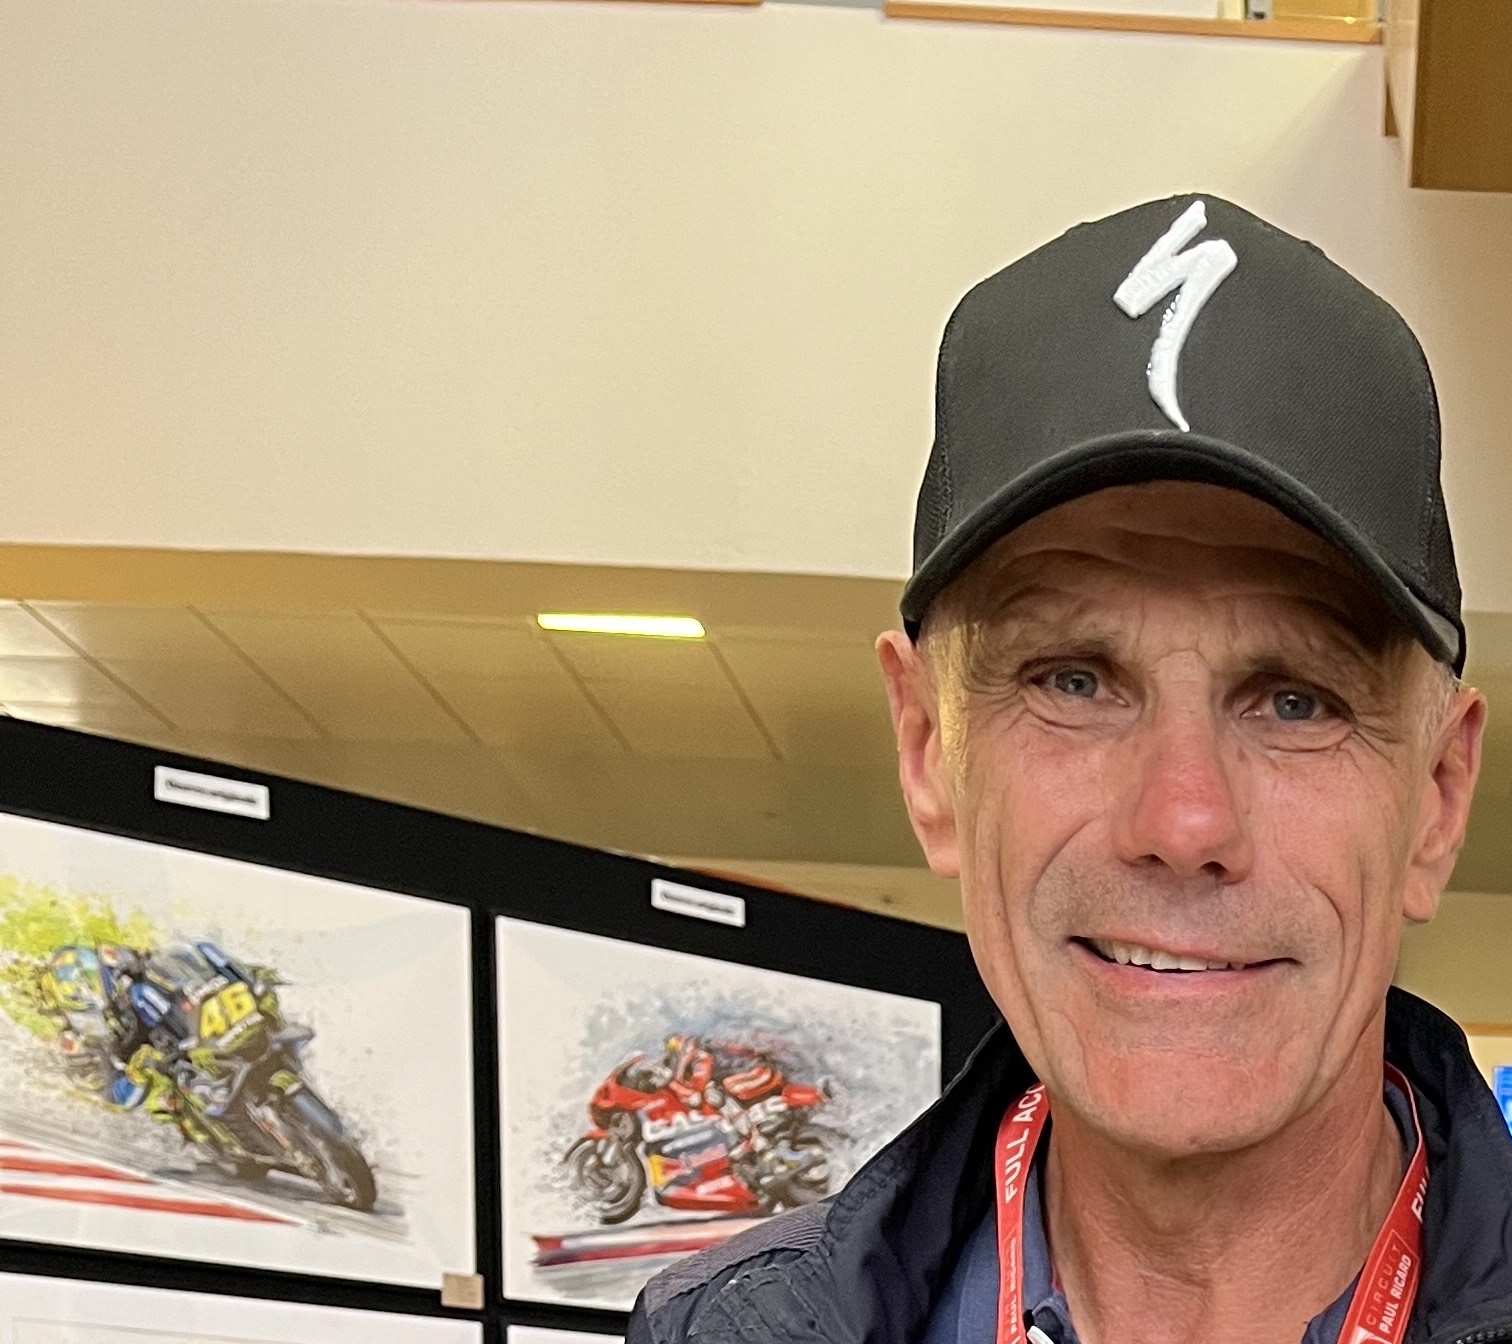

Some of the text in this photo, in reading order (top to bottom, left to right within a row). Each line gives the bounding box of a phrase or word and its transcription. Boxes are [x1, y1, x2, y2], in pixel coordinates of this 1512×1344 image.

[1004, 1127, 1031, 1204] FULL
[1378, 1253, 1413, 1335] PAUL RICARD
